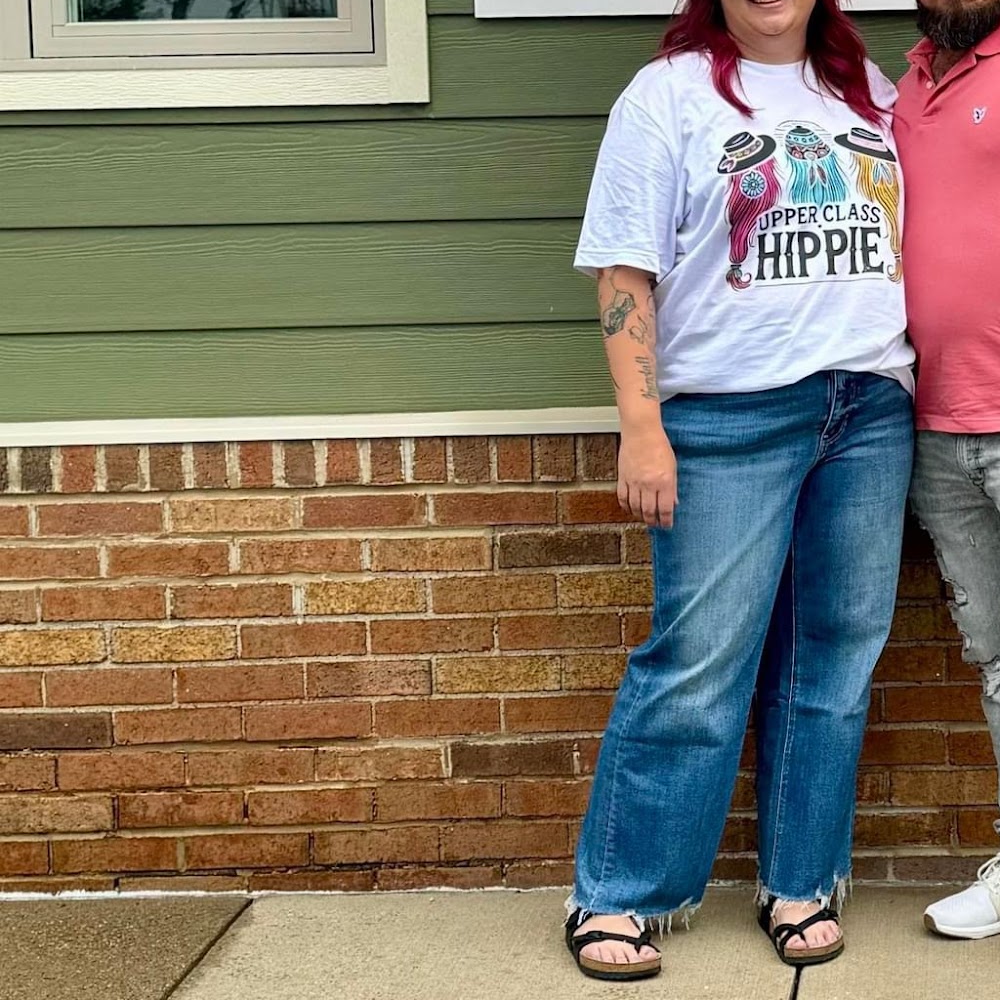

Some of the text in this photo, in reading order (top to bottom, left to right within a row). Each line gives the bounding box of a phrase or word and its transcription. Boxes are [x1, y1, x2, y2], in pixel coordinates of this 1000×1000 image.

[759, 203, 881, 231] UPPER CLASS
[755, 227, 884, 280] HIPPIE
